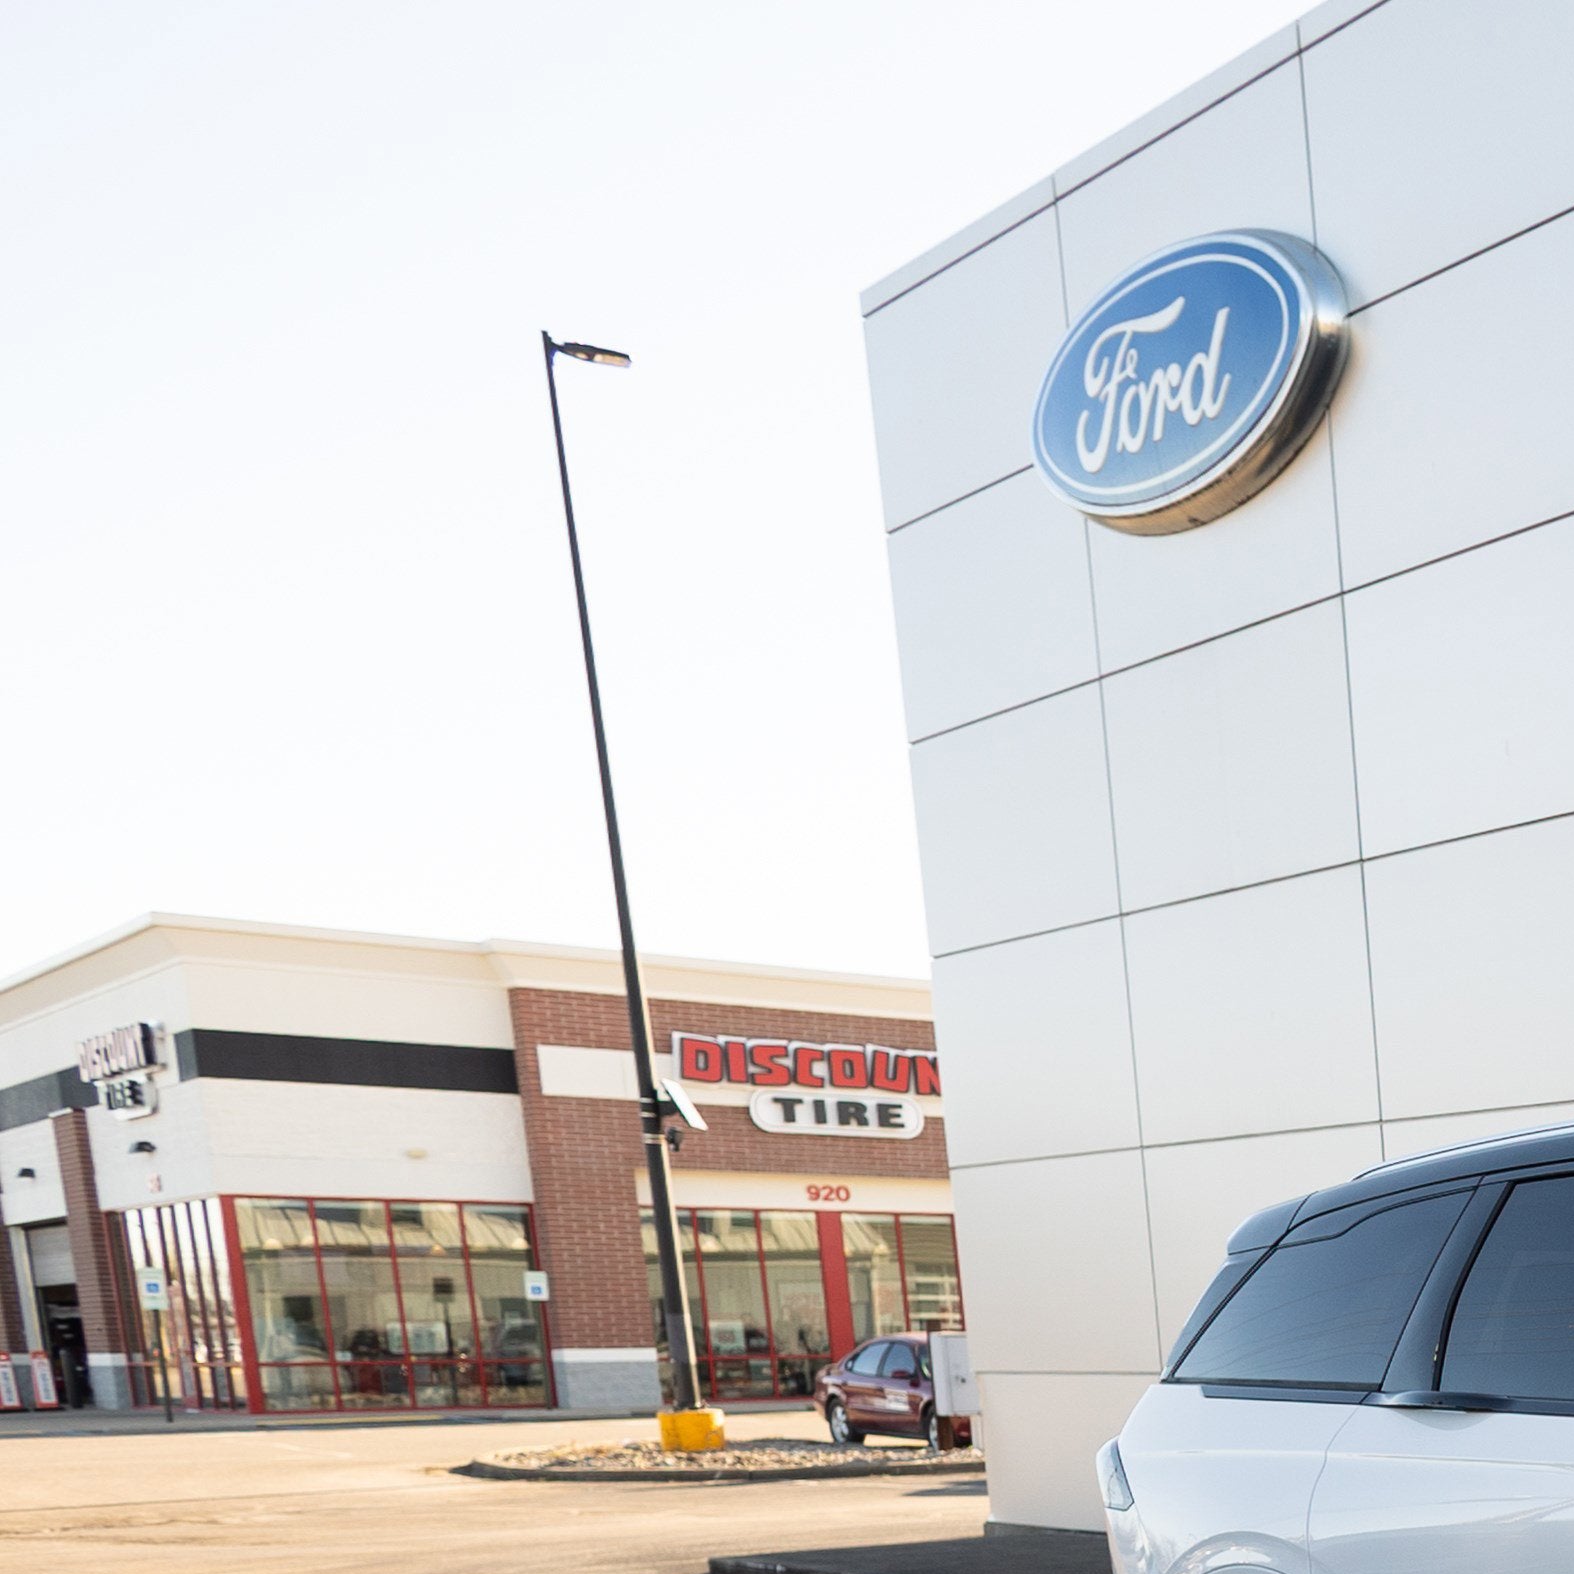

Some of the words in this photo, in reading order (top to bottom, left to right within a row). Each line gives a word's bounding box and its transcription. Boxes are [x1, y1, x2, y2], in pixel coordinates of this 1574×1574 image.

[1078, 296, 1231, 473] Ford
[680, 1037, 941, 1096] DISCOUN
[772, 1097, 905, 1129] TIRE
[805, 1184, 851, 1203] 920
